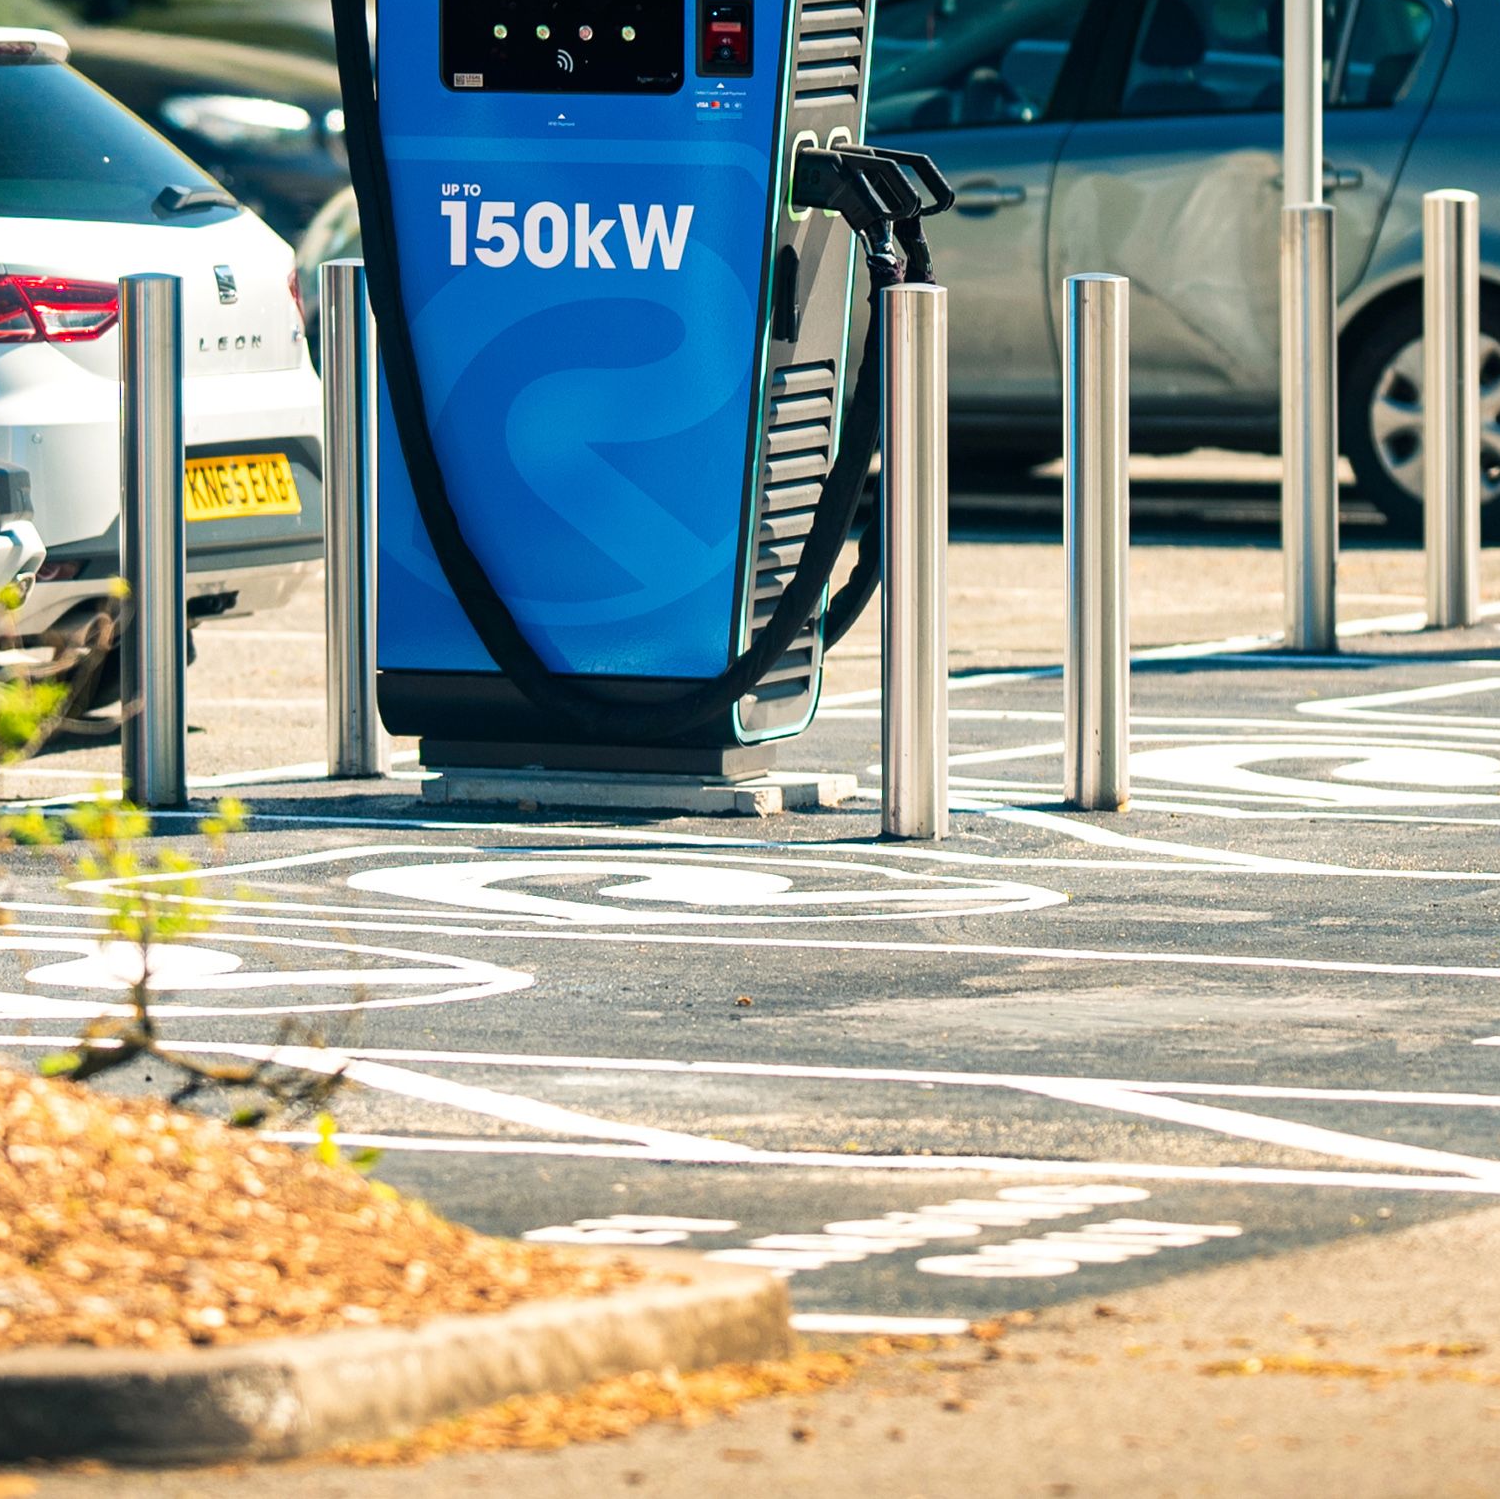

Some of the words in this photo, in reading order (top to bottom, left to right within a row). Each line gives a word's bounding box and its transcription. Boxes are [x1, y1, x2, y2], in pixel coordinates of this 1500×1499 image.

[441, 183, 460, 197] UP
[463, 184, 482, 197] TO
[441, 200, 695, 271] 150kW
[199, 335, 262, 352] LEON
[184, 464, 247, 510] KN65
[704, 1184, 1152, 1278] ARGING
